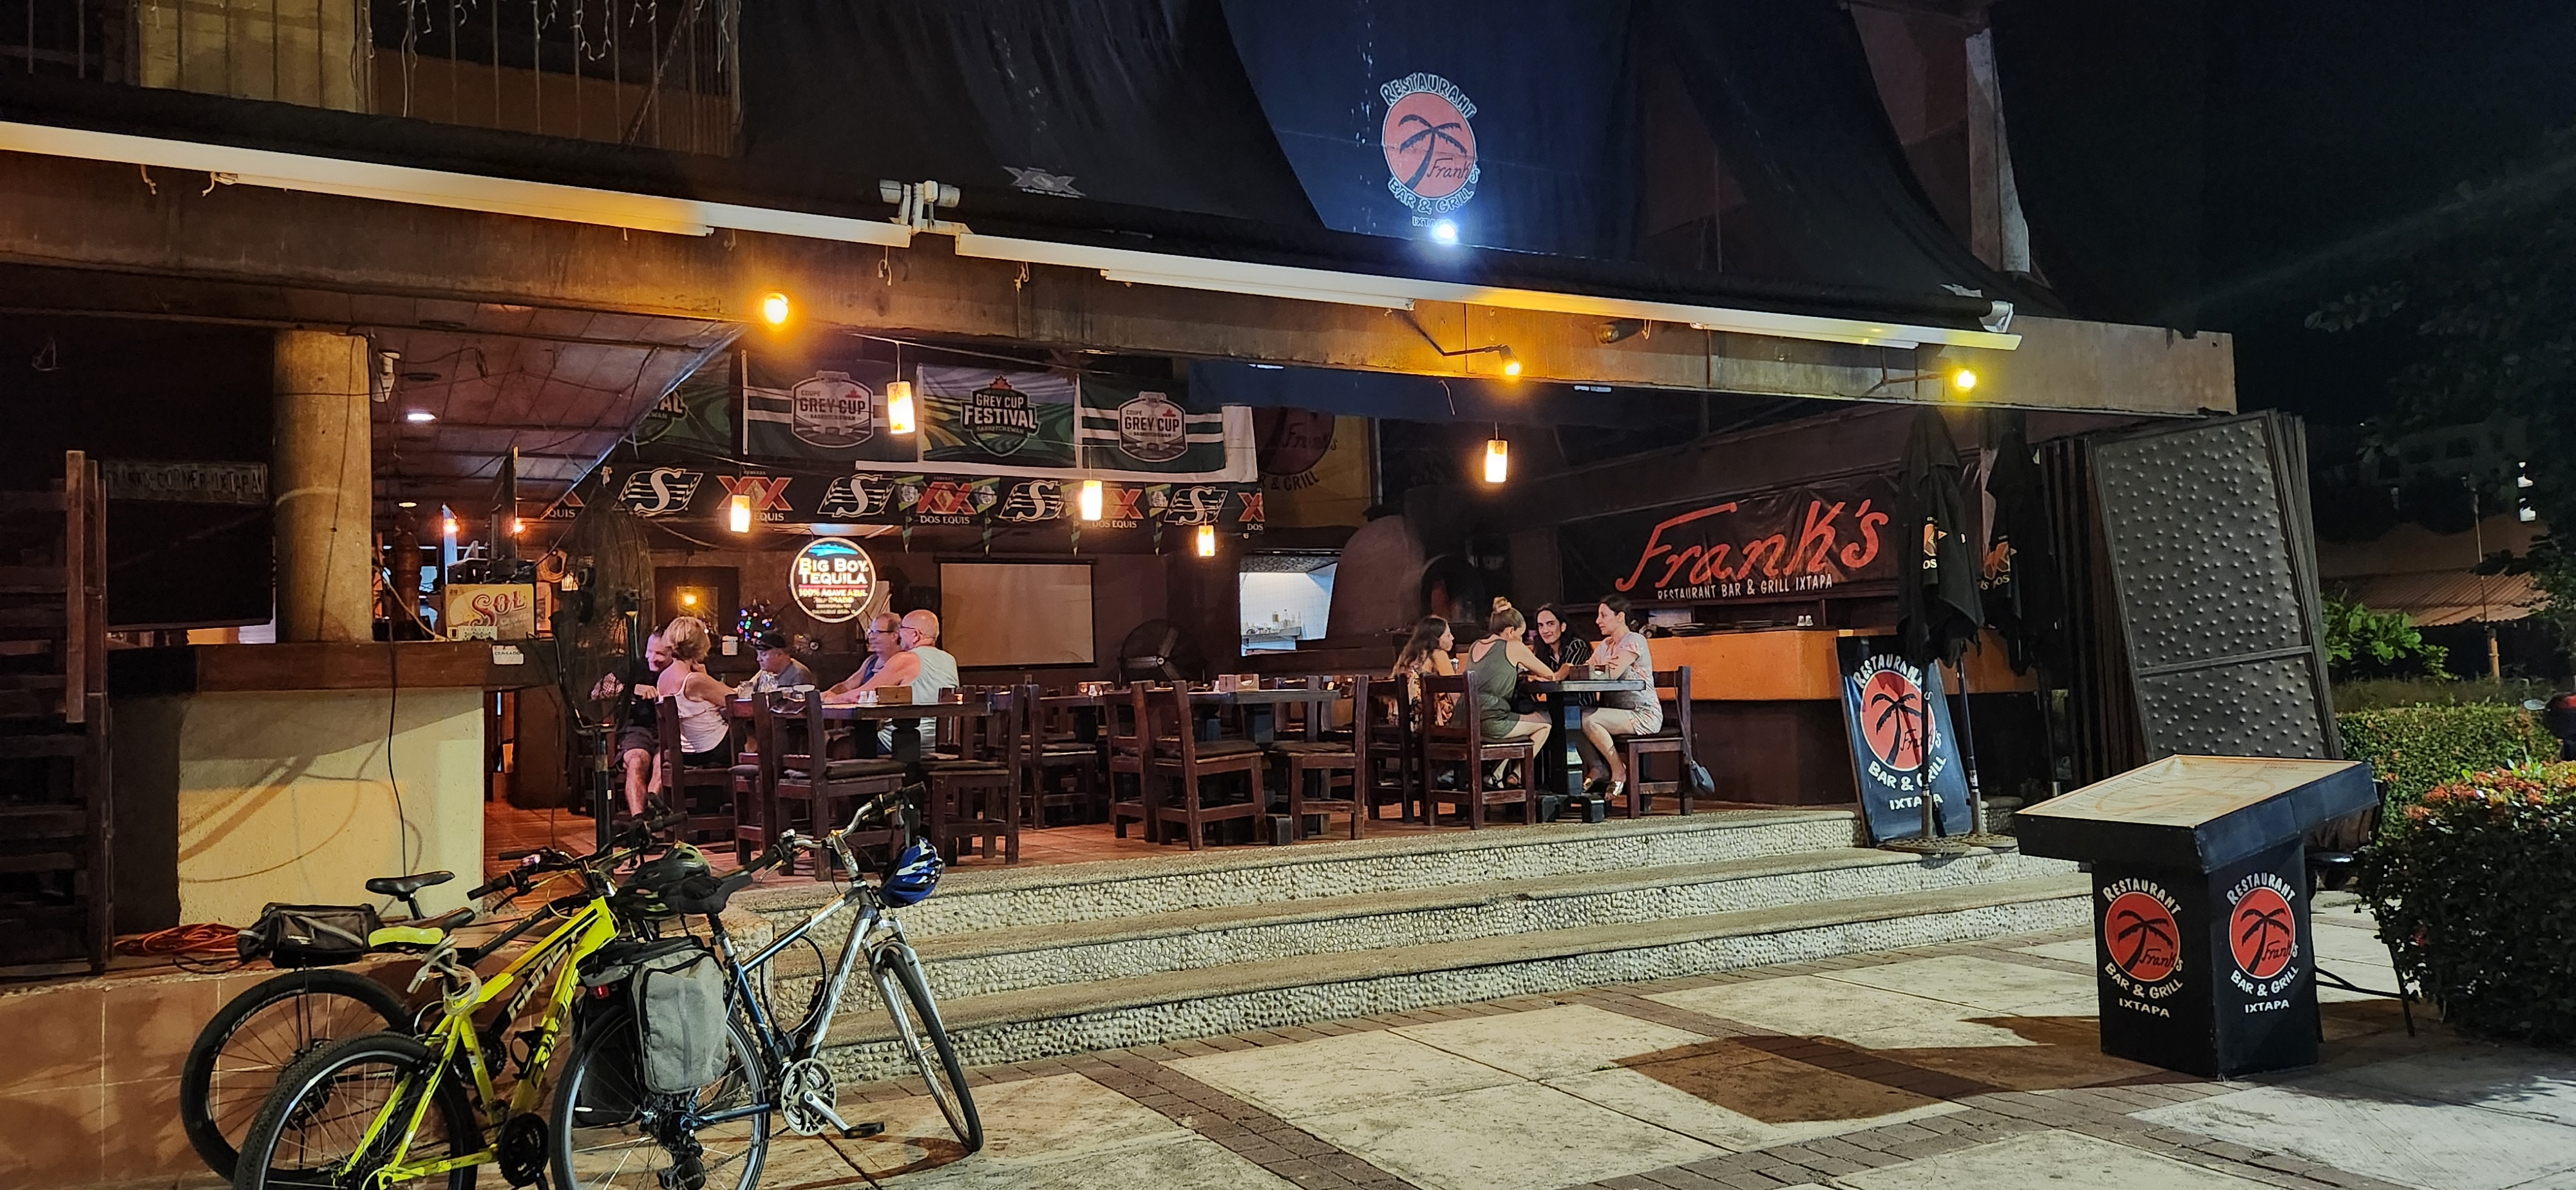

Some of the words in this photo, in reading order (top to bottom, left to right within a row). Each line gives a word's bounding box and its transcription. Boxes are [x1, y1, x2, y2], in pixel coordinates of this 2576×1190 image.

[1380, 72, 1477, 119] RESTAURANT
[1388, 176, 1416, 209] BAR
[1418, 200, 1432, 214] &
[1435, 187, 1474, 212] GRILL
[800, 397, 835, 413] GREY
[838, 399, 866, 415] CUP
[976, 393, 1002, 407] GREY
[1005, 397, 1024, 409] CUP
[964, 404, 1037, 430] FESTIVAL
[1124, 416, 1154, 431] GREY
[1157, 418, 1180, 432] CUP
[1283, 471, 1319, 491] GRILL
[916, 481, 977, 514] XX
[548, 509, 575, 518] QUIS
[920, 515, 940, 524] DOS
[943, 516, 971, 525] EQUIS
[1092, 520, 1110, 529] DOS
[1112, 520, 1137, 529] EQUIS
[1615, 498, 1889, 592] Frank's
[799, 557, 830, 572] BIG
[1923, 558, 1937, 569] OS
[798, 571, 868, 585] TEQUILA
[1658, 585, 1716, 600] RESTAURANT
[1721, 582, 1741, 597] BAR
[1747, 579, 1756, 595] &
[1761, 579, 1790, 594] GRILL
[1795, 574, 1833, 591] IXTAPA
[799, 588, 820, 597] 100%
[471, 590, 527, 627] SOL
[1868, 760, 1897, 789] BAR
[1900, 777, 1914, 791] &
[1889, 793, 1944, 810] IXTAA
[2103, 878, 2182, 914] RESTAURANT
[2226, 873, 2296, 905] RESTAURANT
[2105, 962, 2130, 990] BAR
[2133, 984, 2145, 998] &
[2149, 979, 2184, 999] GRILL
[2231, 970, 2254, 994] BAR
[2257, 984, 2268, 997] &
[2271, 966, 2300, 994] GRILL
[2119, 997, 2170, 1018] IXTAPA
[2245, 999, 2290, 1014] IXTAPA
